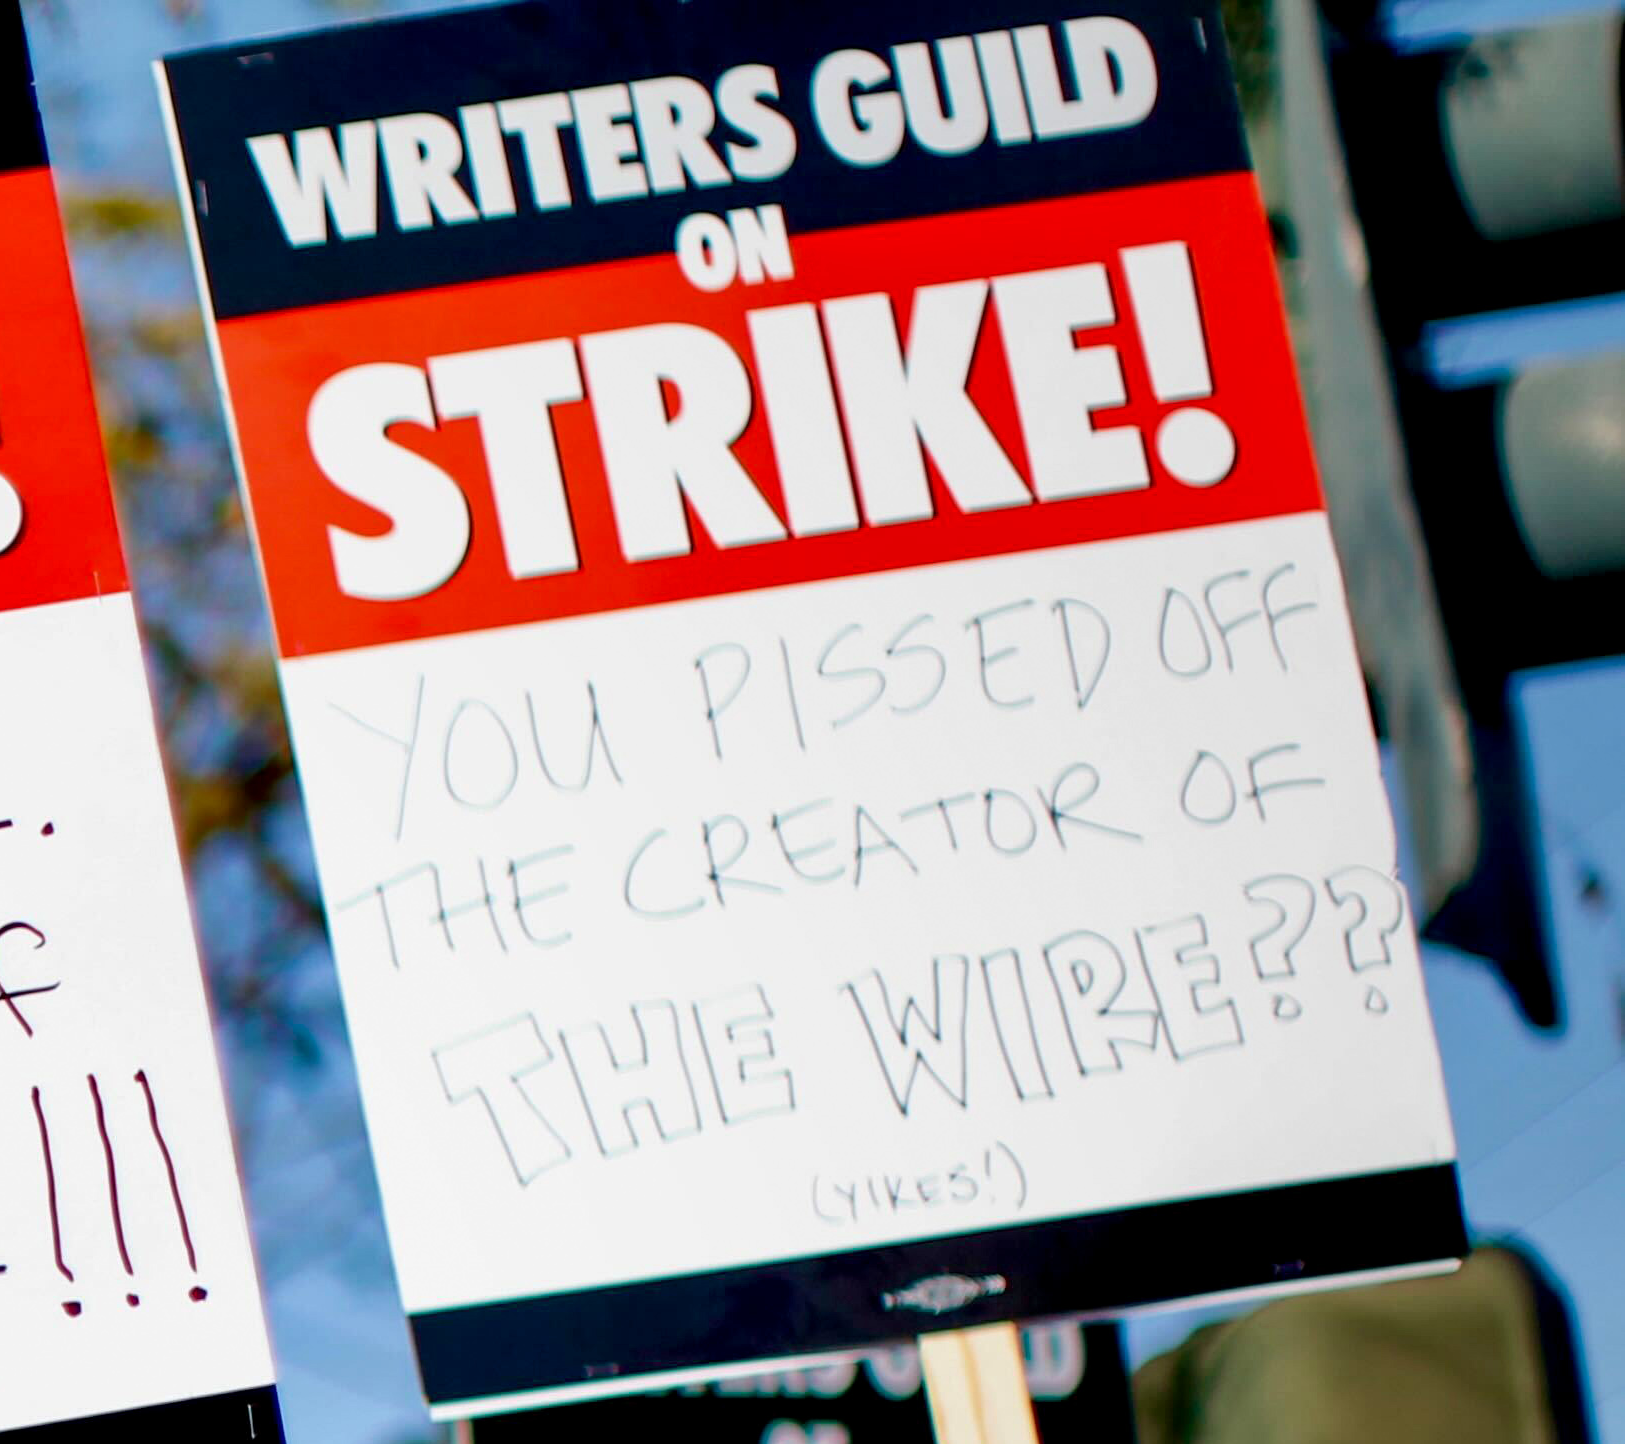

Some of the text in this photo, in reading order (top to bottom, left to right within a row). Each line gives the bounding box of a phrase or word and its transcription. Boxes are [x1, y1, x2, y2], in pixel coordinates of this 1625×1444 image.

[247, 14, 1159, 247] WRITERS GUILD
[675, 203, 793, 291] ON
[305, 240, 1237, 600] STRIKE!
[326, 563, 1318, 842] YOU PISSED OFF
[336, 743, 1325, 969] THE CREATOR OF
[431, 983, 796, 1188] THE
